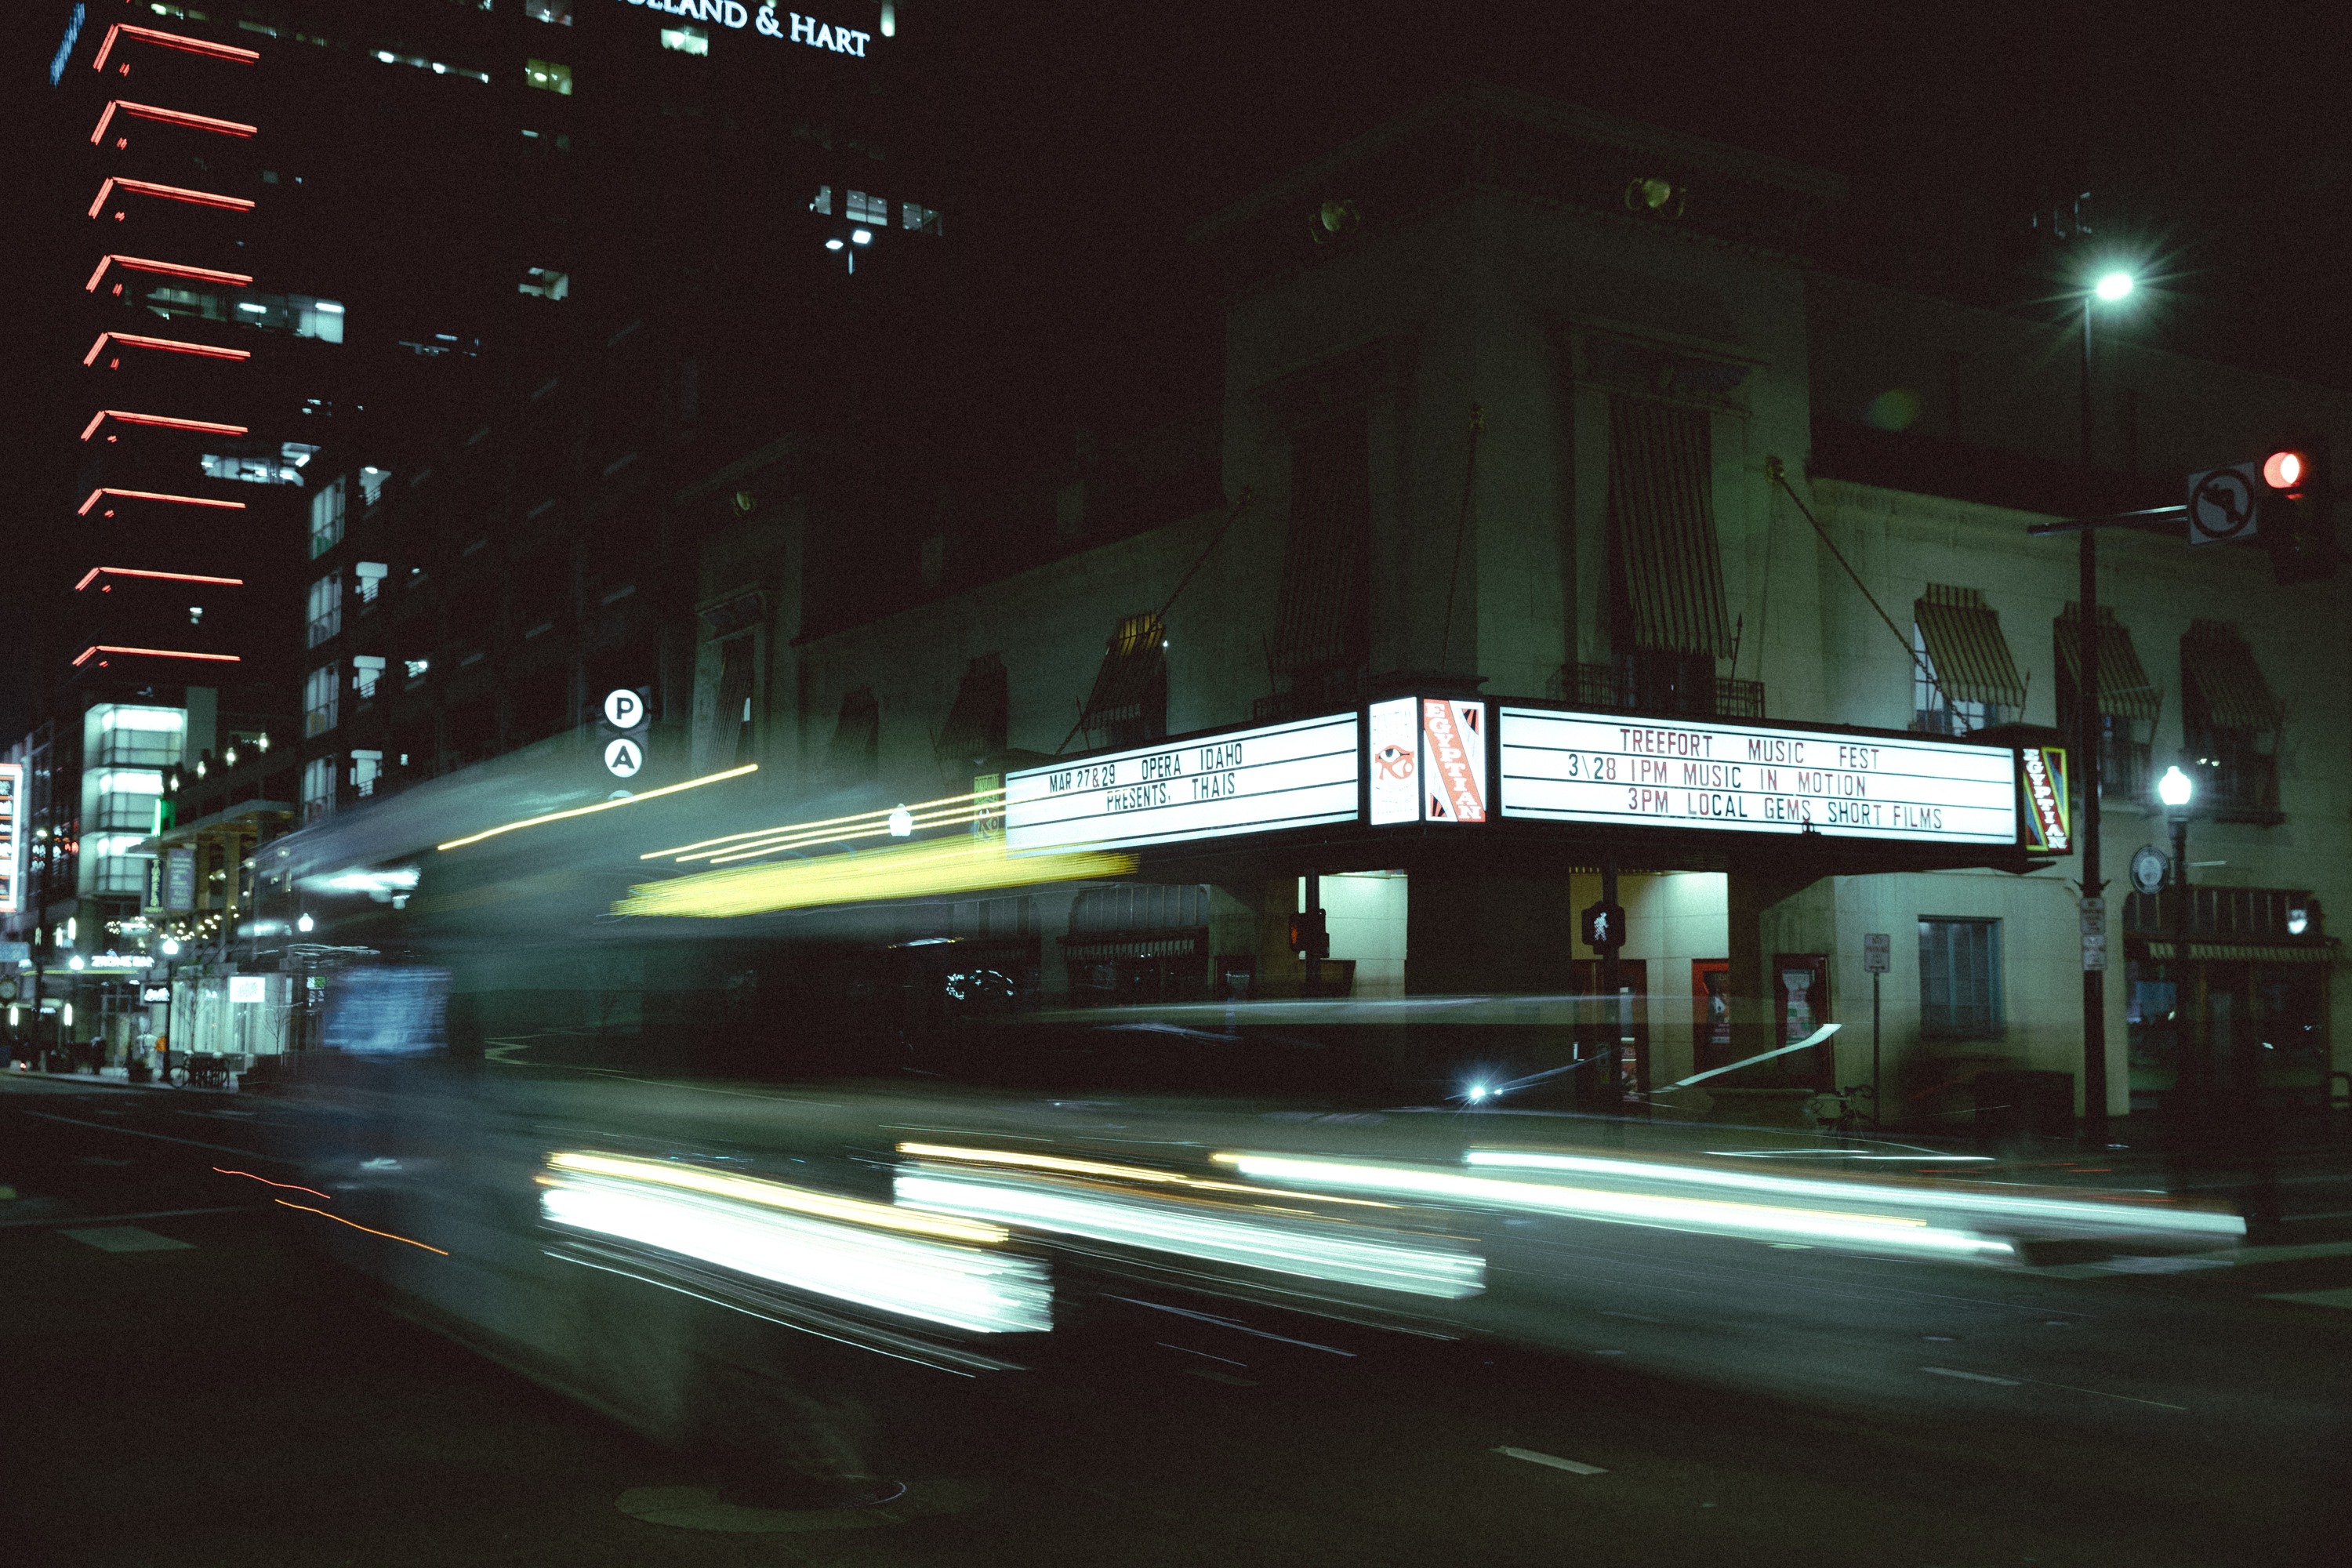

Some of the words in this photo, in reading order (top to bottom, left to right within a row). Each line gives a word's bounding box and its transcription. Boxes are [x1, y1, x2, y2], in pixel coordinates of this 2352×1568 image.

[756, 5, 784, 38] &
[789, 12, 870, 57] HART
[616, 697, 634, 720] P
[611, 745, 635, 769] A
[1050, 772, 1072, 793] MAR
[1142, 754, 1181, 780] OPERA
[1200, 743, 1242, 771] IDAHO
[1425, 702, 1482, 820] EGYPTIAN
[1620, 728, 1712, 757] TREEFORT
[1748, 739, 1804, 764] MUSIC
[1840, 746, 1879, 769] FEST
[1192, 772, 1236, 800] THAIS
[1632, 759, 1668, 783] 1PM
[1684, 763, 1741, 788] MUSIC
[1761, 768, 1777, 791] IN
[1798, 771, 1865, 797] MOTION
[1628, 787, 1668, 813] 3PM
[1688, 793, 1748, 817] LOCAL
[1765, 797, 1810, 822] GEMS
[1828, 801, 1882, 826] SHORT
[1894, 806, 1942, 829] FILMS
[2023, 749, 2067, 849] EGYPTIAN
